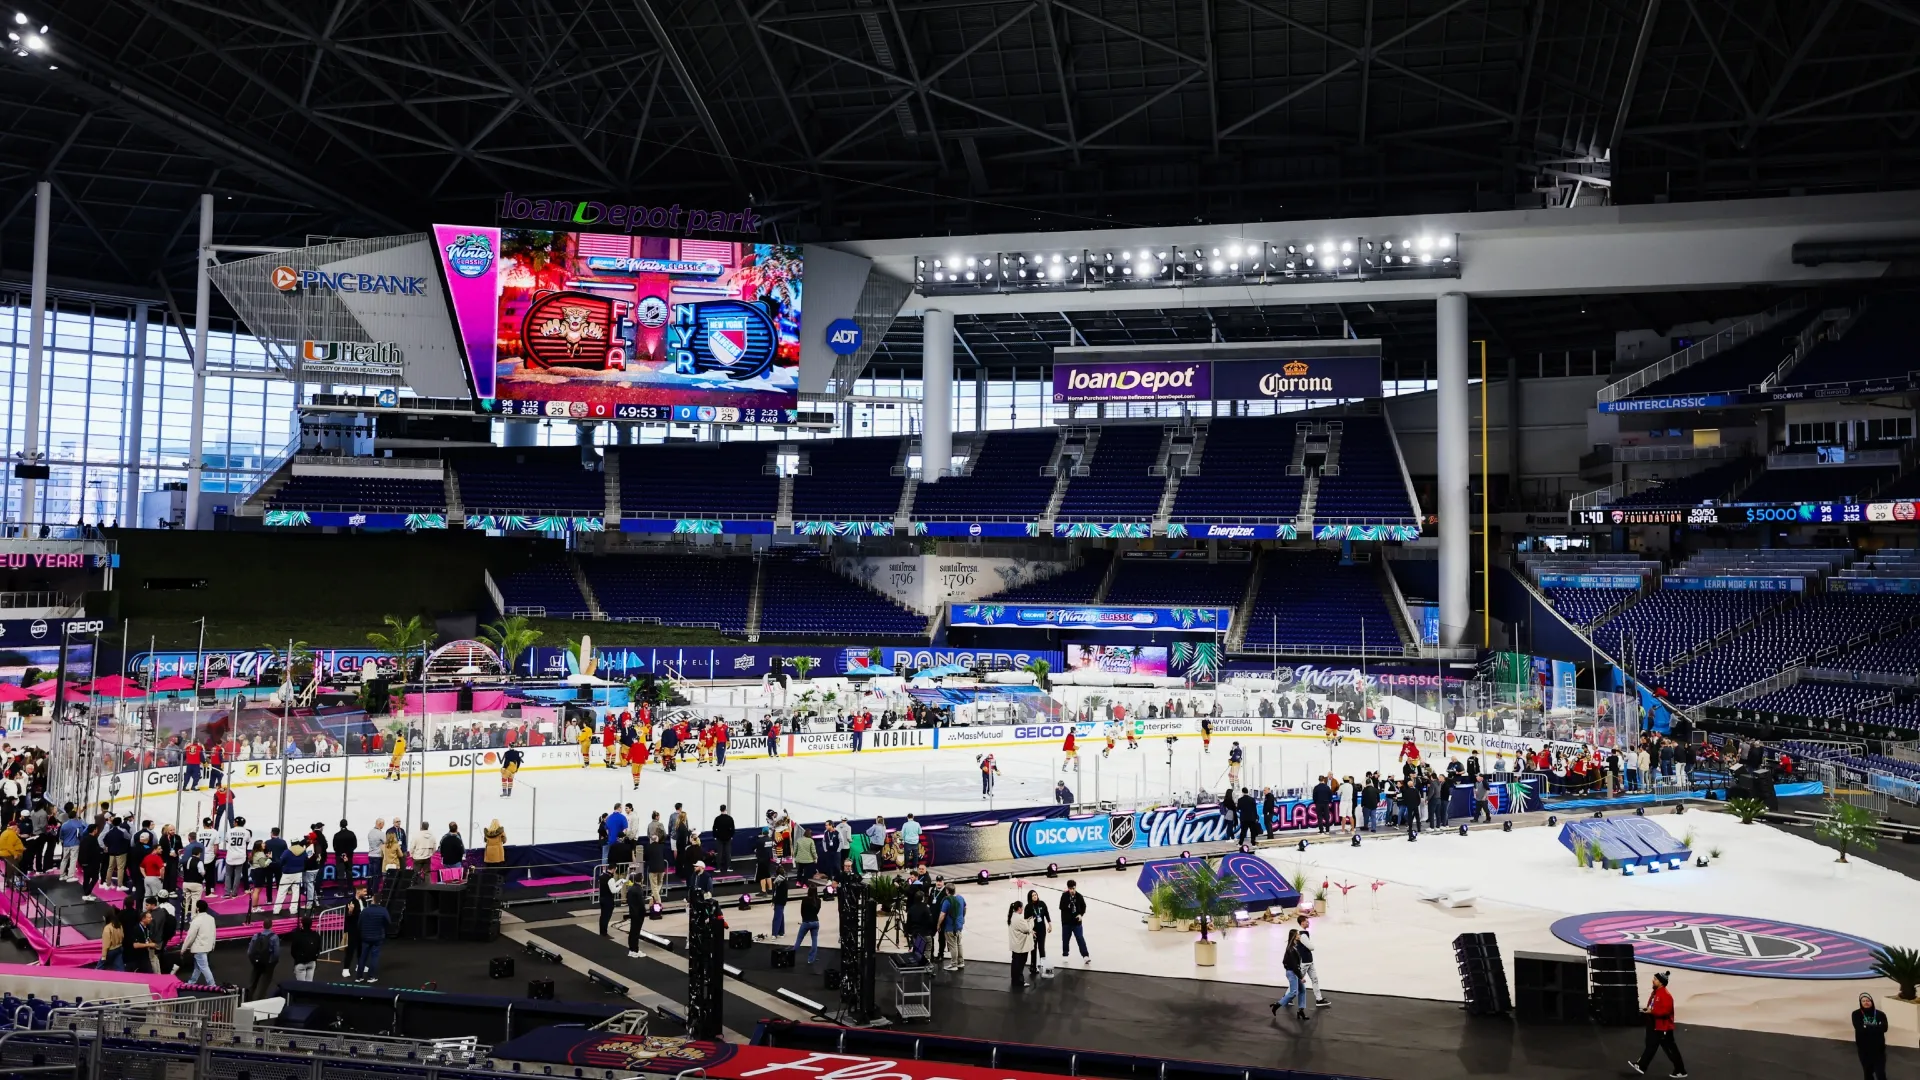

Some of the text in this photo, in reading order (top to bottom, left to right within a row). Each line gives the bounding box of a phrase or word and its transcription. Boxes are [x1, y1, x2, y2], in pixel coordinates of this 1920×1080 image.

[502, 192, 760, 236] loanDepot park
[445, 244, 494, 262] Winter
[626, 258, 668, 272] Winter
[302, 270, 427, 295] PNC BANK
[710, 320, 743, 329] NEW YORK
[678, 303, 695, 373] NYR
[712, 331, 740, 357] RANGERS
[830, 330, 858, 345] ADT
[1067, 367, 1195, 392] loanDepot
[1259, 372, 1333, 397] Corona
[381, 394, 395, 404] 42
[1773, 392, 1804, 400] DISCOVER
[551, 407, 563, 415] 29
[596, 405, 605, 415] 0
[1608, 397, 1706, 412] #WINTERCLASSIC
[619, 406, 657, 418] 49:53
[681, 408, 690, 418] 0
[721, 413, 733, 421] 25
[1746, 508, 1797, 522] $5000
[1820, 505, 1832, 513] 96
[1580, 512, 1604, 523] 1:40
[1625, 513, 1682, 522] FOUNDATION
[1687, 515, 1718, 523] RAFFLE
[1208, 525, 1255, 538] Energizer
[33, 554, 84, 568] YEAR!
[891, 572, 914, 588] 1796
[943, 573, 975, 590] 1796
[1704, 580, 1787, 589] LEARN MORE AT SEC. 15
[1056, 609, 1134, 624] Winter CLASSIC
[67, 621, 103, 633] GEICO
[1234, 671, 1272, 680] DISCOVER
[1380, 673, 1441, 686] CLASSIC
[1076, 725, 1092, 736] SAP
[1137, 721, 1182, 732] enterprise
[1271, 719, 1294, 729] SN
[873, 730, 924, 748] NOBULL
[957, 730, 1003, 741] MassMutual
[1015, 726, 1064, 739] GEICO
[807, 743, 834, 751] CRUISE
[147, 770, 183, 785] Grea
[1035, 824, 1104, 845] DISCOVER
[1114, 822, 1132, 840] NHL
[230, 837, 244, 847] 30
[1705, 931, 1747, 956] NHL
